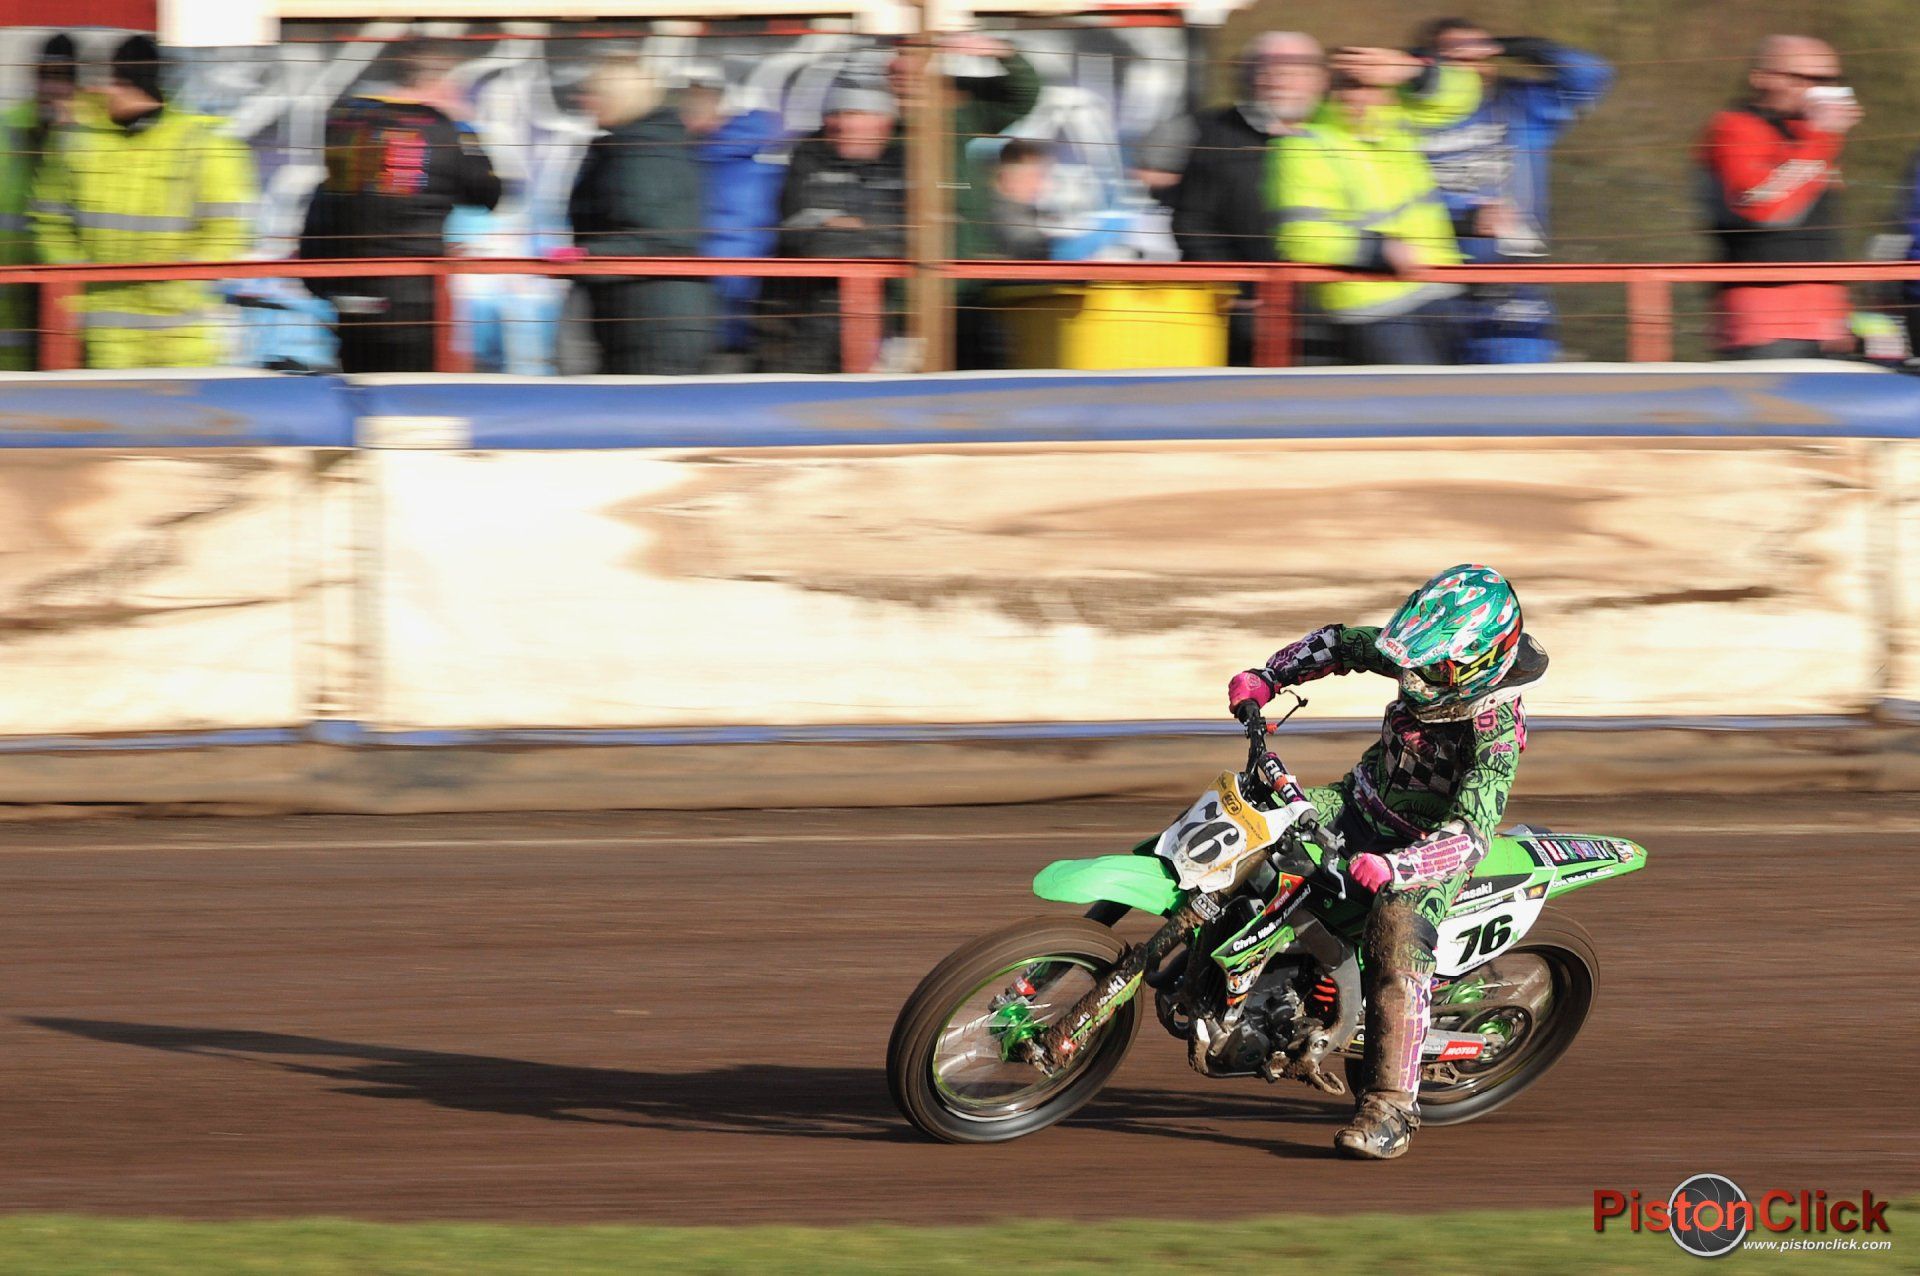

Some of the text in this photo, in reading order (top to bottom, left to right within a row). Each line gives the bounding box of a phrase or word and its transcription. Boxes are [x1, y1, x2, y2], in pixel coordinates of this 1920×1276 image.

[1177, 801, 1240, 864] 76
[1456, 882, 1493, 903] asaki
[1232, 934, 1257, 952] Chris
[1456, 914, 1513, 966] 76
[1444, 1046, 1479, 1055] MOTUL
